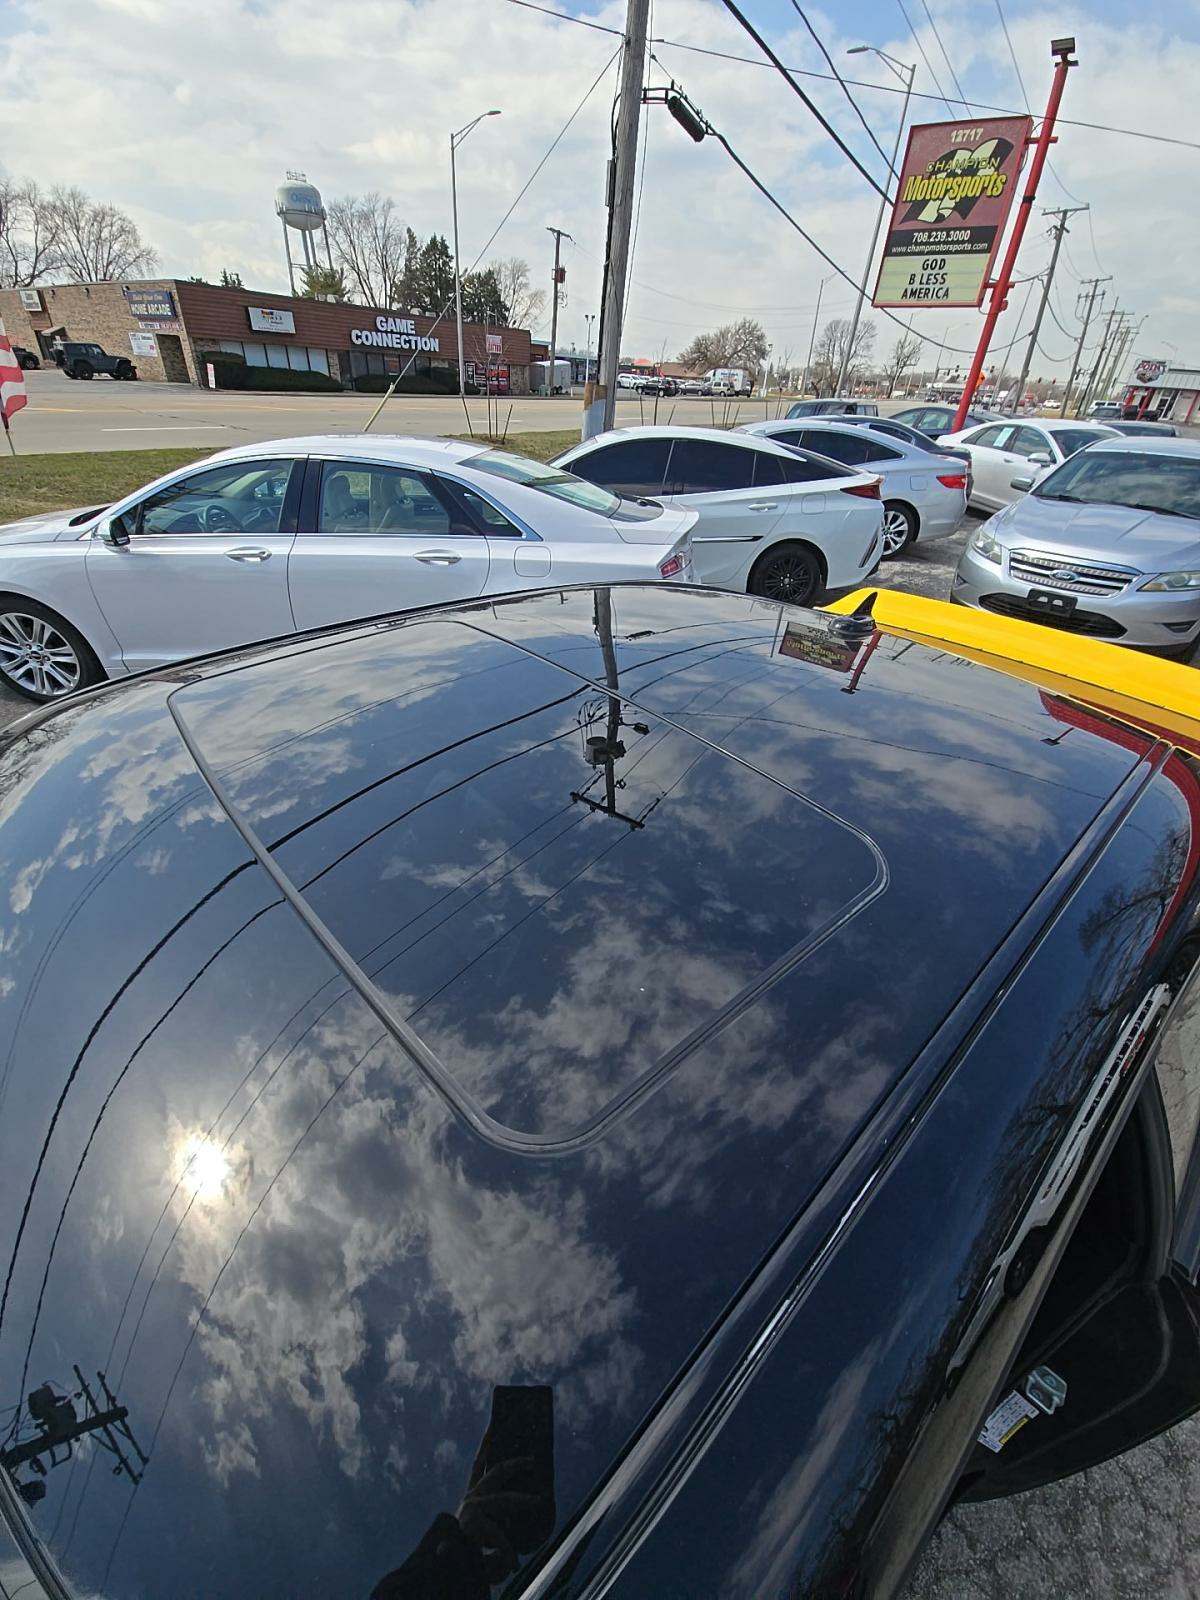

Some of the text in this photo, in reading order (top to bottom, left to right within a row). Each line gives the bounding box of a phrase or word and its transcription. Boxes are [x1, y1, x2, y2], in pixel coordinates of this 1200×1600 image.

[951, 128, 984, 143] 12717
[926, 157, 1000, 172] CHAMPION
[902, 173, 1007, 202] Motorsports
[912, 230, 971, 243] 708.239.3000
[922, 258, 946, 271] GOD
[901, 287, 950, 300] AMERICA
[375, 316, 416, 335] GAME
[350, 329, 439, 352] CONNECTION
